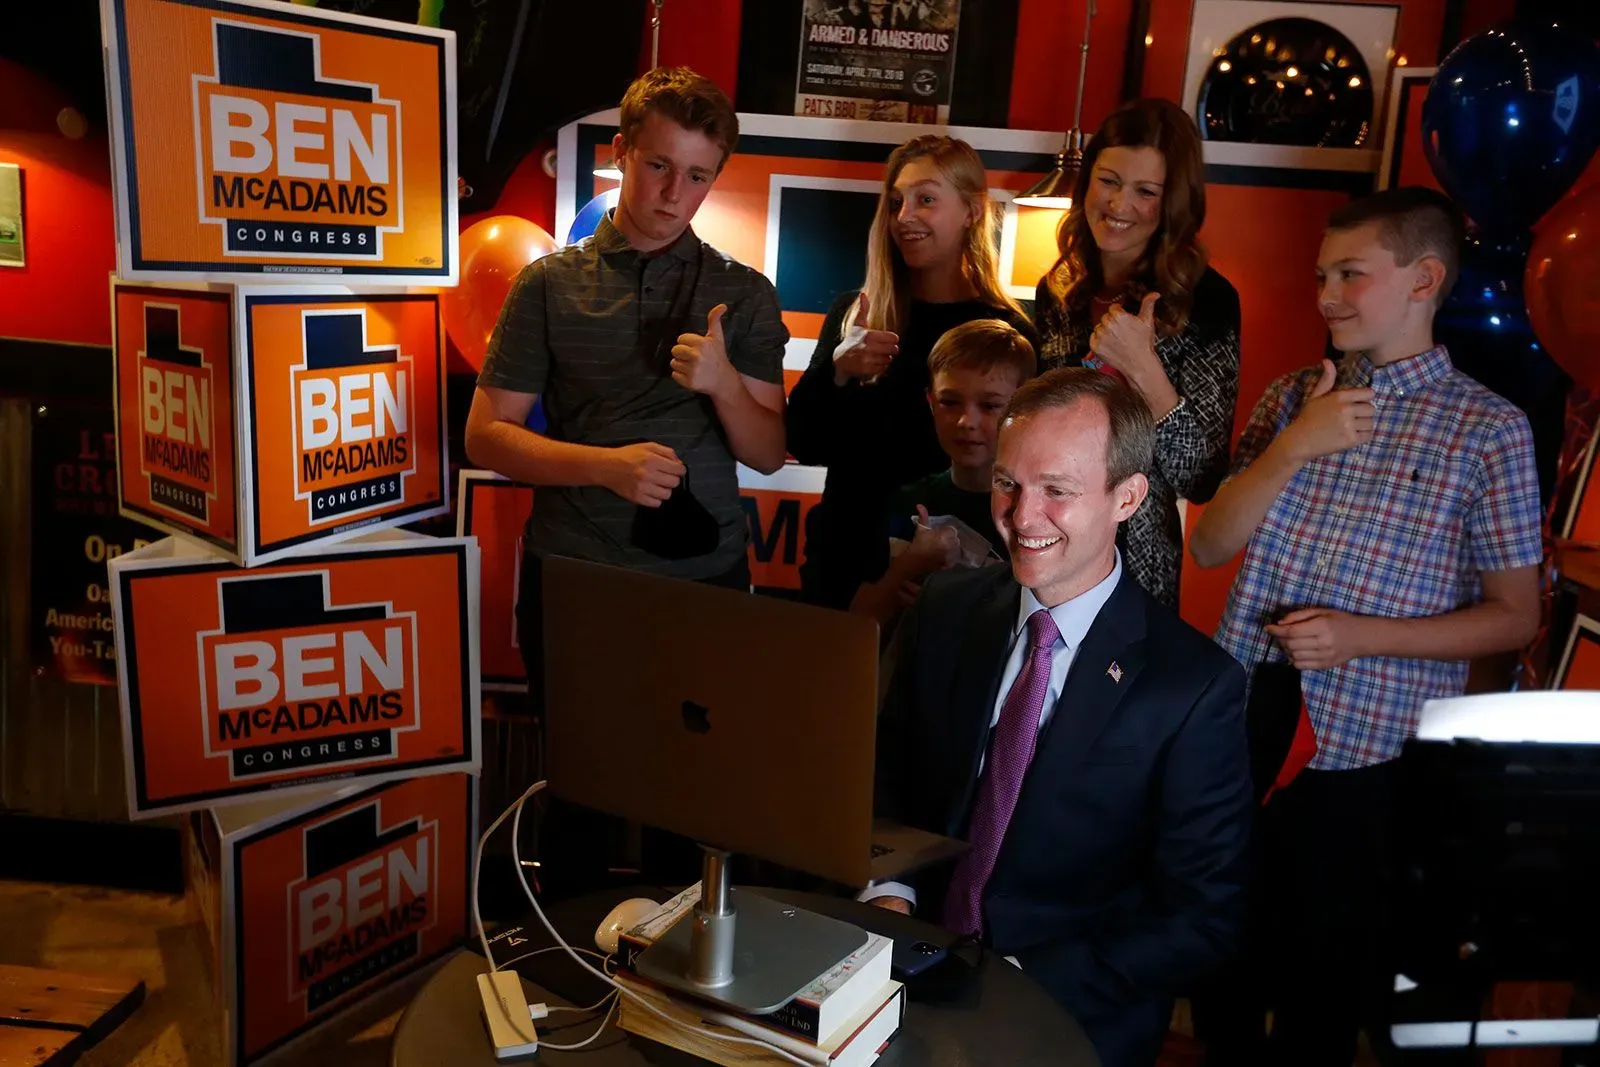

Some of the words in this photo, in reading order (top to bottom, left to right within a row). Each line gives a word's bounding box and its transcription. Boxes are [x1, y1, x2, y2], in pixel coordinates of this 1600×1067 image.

[808, 23, 856, 45] ARMED
[858, 28, 869, 46] &
[871, 28, 950, 53] DANGEROUS
[845, 66, 866, 78] APRIL
[884, 68, 905, 81] 2018
[803, 98, 833, 117] PAT'S
[834, 100, 857, 119] BBQ
[209, 93, 389, 184] BEN
[213, 175, 388, 216] McADAMS
[236, 227, 368, 245] CONGRESS
[142, 365, 210, 450] BEN
[300, 369, 408, 450] BEN
[144, 432, 211, 483] McADAMS
[303, 436, 408, 482] McADAMS
[153, 481, 204, 511] CONGRESS
[316, 480, 396, 511] CONGRESS
[84, 533, 123, 564] On
[214, 626, 404, 711] BEN
[218, 690, 403, 742] McADAMS
[243, 736, 381, 767] CONGRESS
[299, 836, 429, 954] BEN
[300, 896, 428, 984] McADAMS
